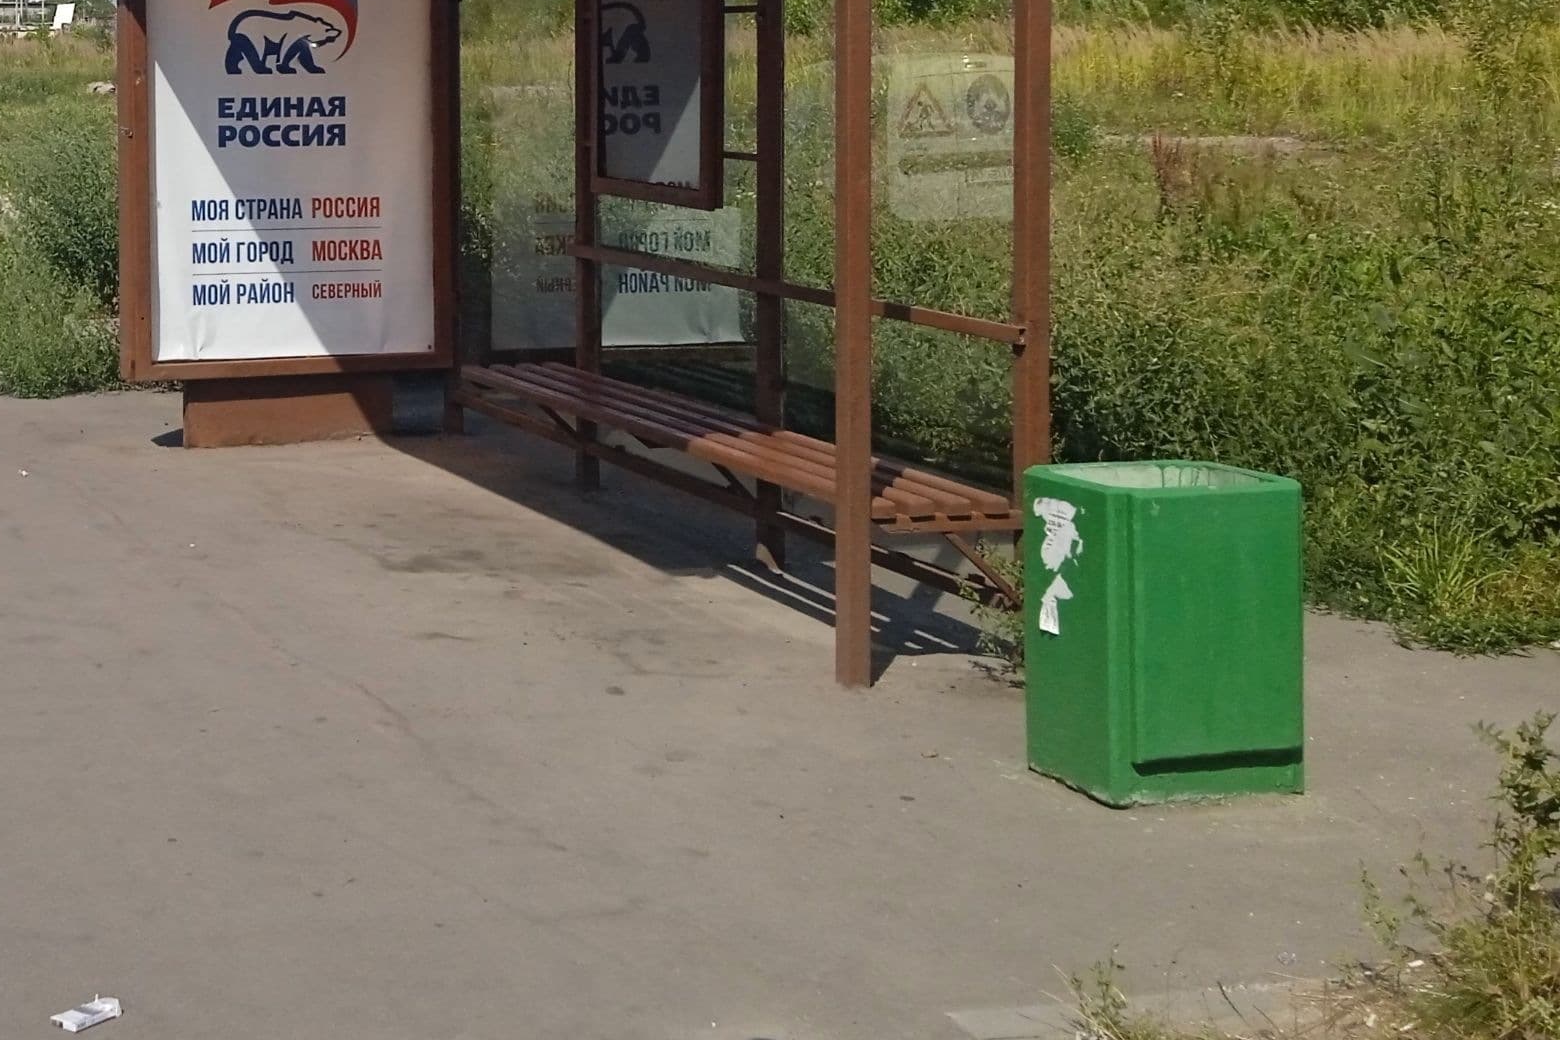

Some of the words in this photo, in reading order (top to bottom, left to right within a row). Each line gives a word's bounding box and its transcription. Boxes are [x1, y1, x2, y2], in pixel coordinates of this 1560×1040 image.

[218, 96, 346, 121] ЕДИНАЯ
[218, 123, 346, 148] РОССИЯ
[192, 199, 229, 221] МОЯ
[235, 198, 303, 220] СТРАНА
[312, 196, 380, 219] РОССИЯ
[192, 238, 230, 264] МОЙ
[236, 241, 294, 264] ГОРОД
[312, 239, 382, 261] МОСКВА
[192, 280, 230, 306] МОЙ
[236, 278, 294, 305] РАЙОН
[312, 280, 382, 299] СЕВЕРНЫЙ
